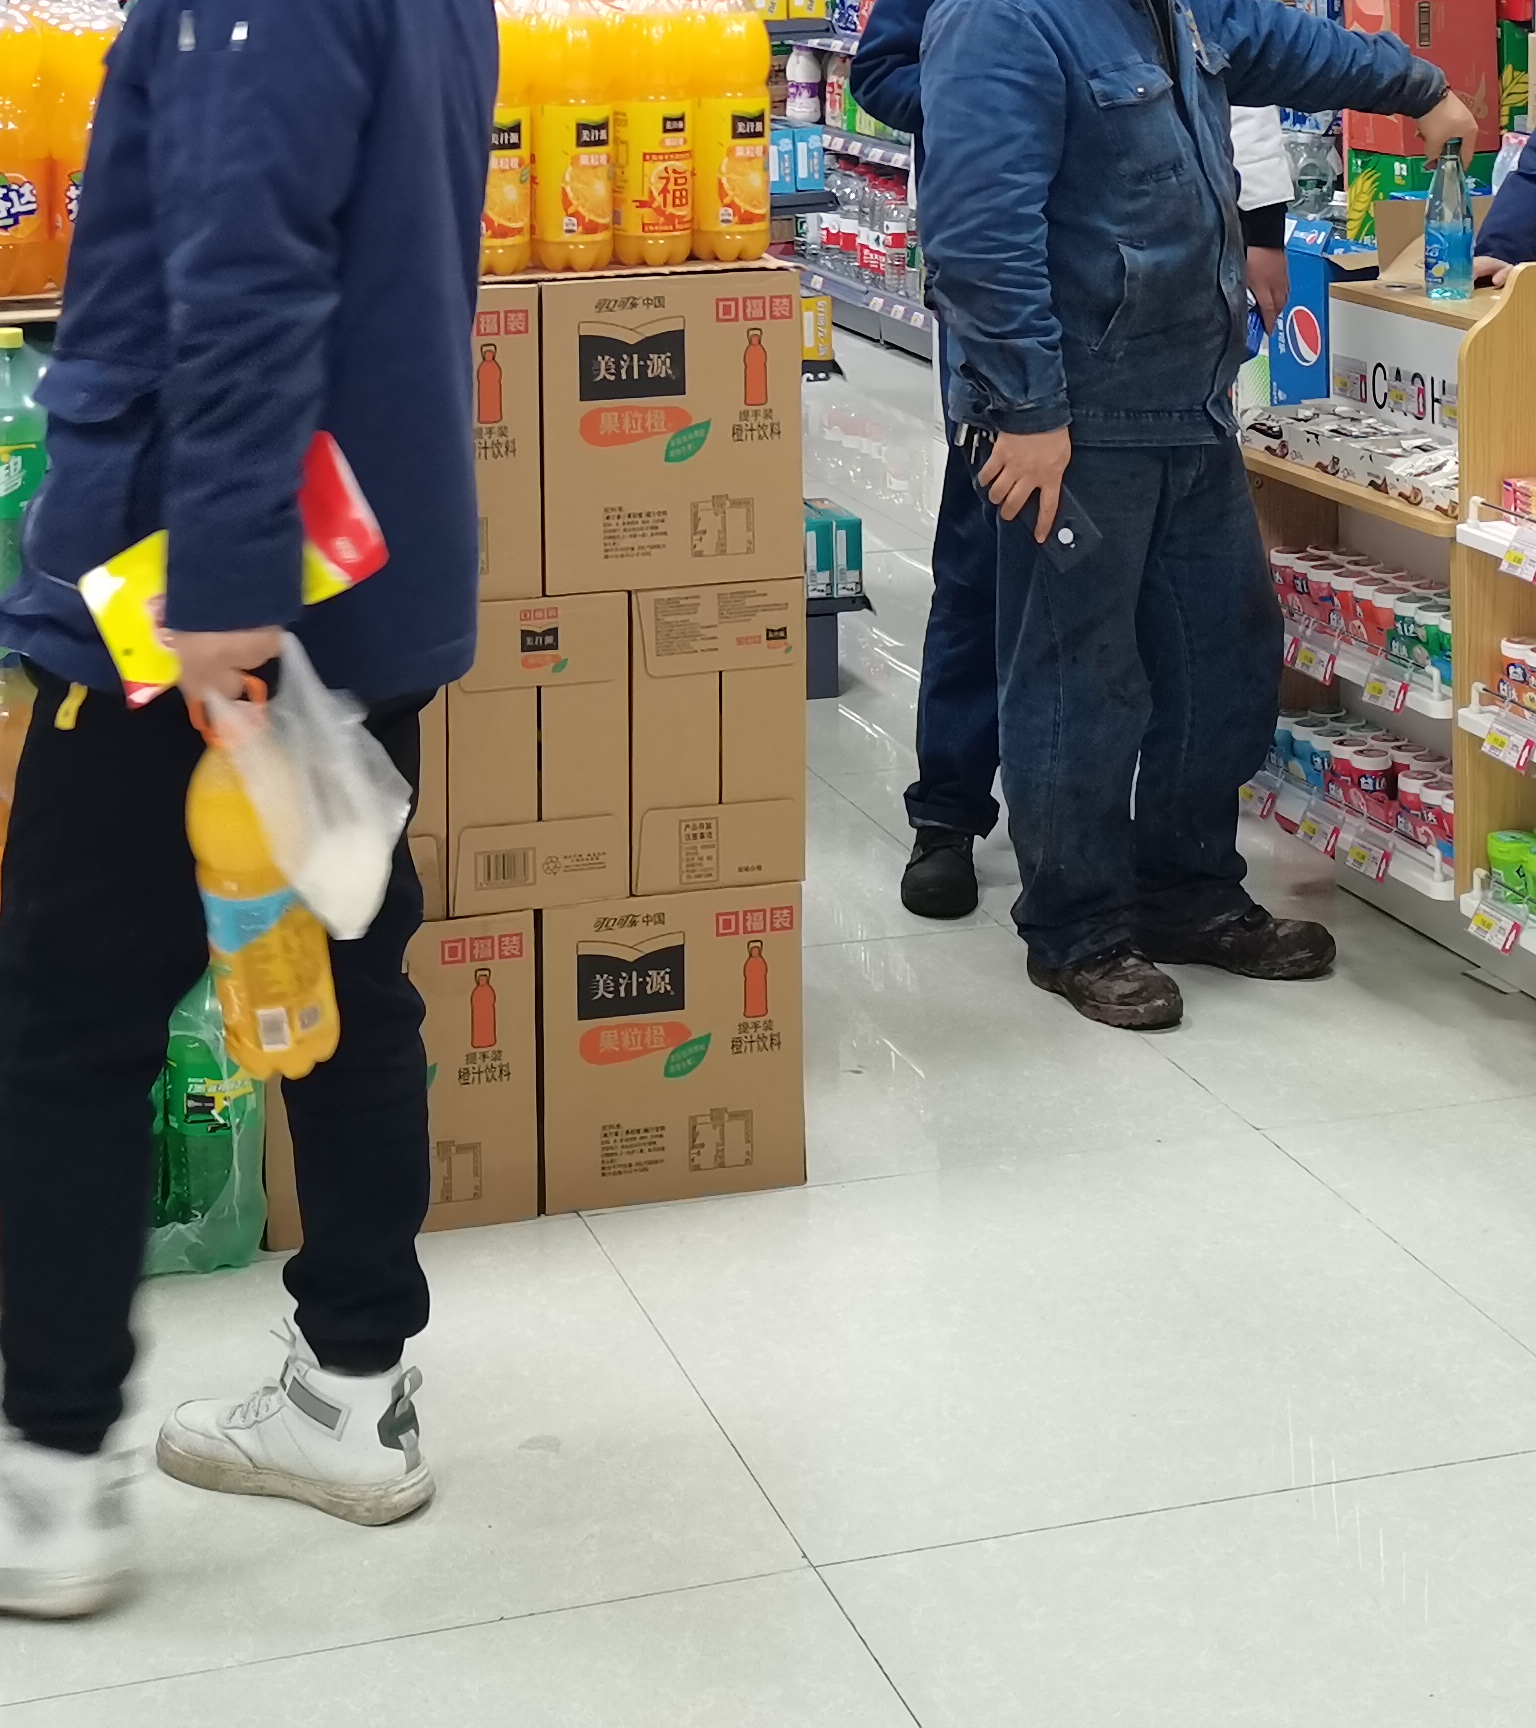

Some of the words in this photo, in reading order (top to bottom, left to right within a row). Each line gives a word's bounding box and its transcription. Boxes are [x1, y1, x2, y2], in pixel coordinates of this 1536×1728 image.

[657, 165, 690, 209] 福
[641, 295, 666, 310] 中国
[592, 351, 675, 384] 美汁源
[598, 408, 670, 435] 果粒橙
[731, 421, 782, 443] 橙汁饮料
[473, 439, 517, 460] 汁饮料
[641, 912, 666, 927] 中国
[590, 968, 676, 1000] 美汁源
[598, 1025, 668, 1053] 果粒橙
[729, 1030, 782, 1056] 橙汁饮料
[457, 1061, 511, 1086] 橙汁饮料
